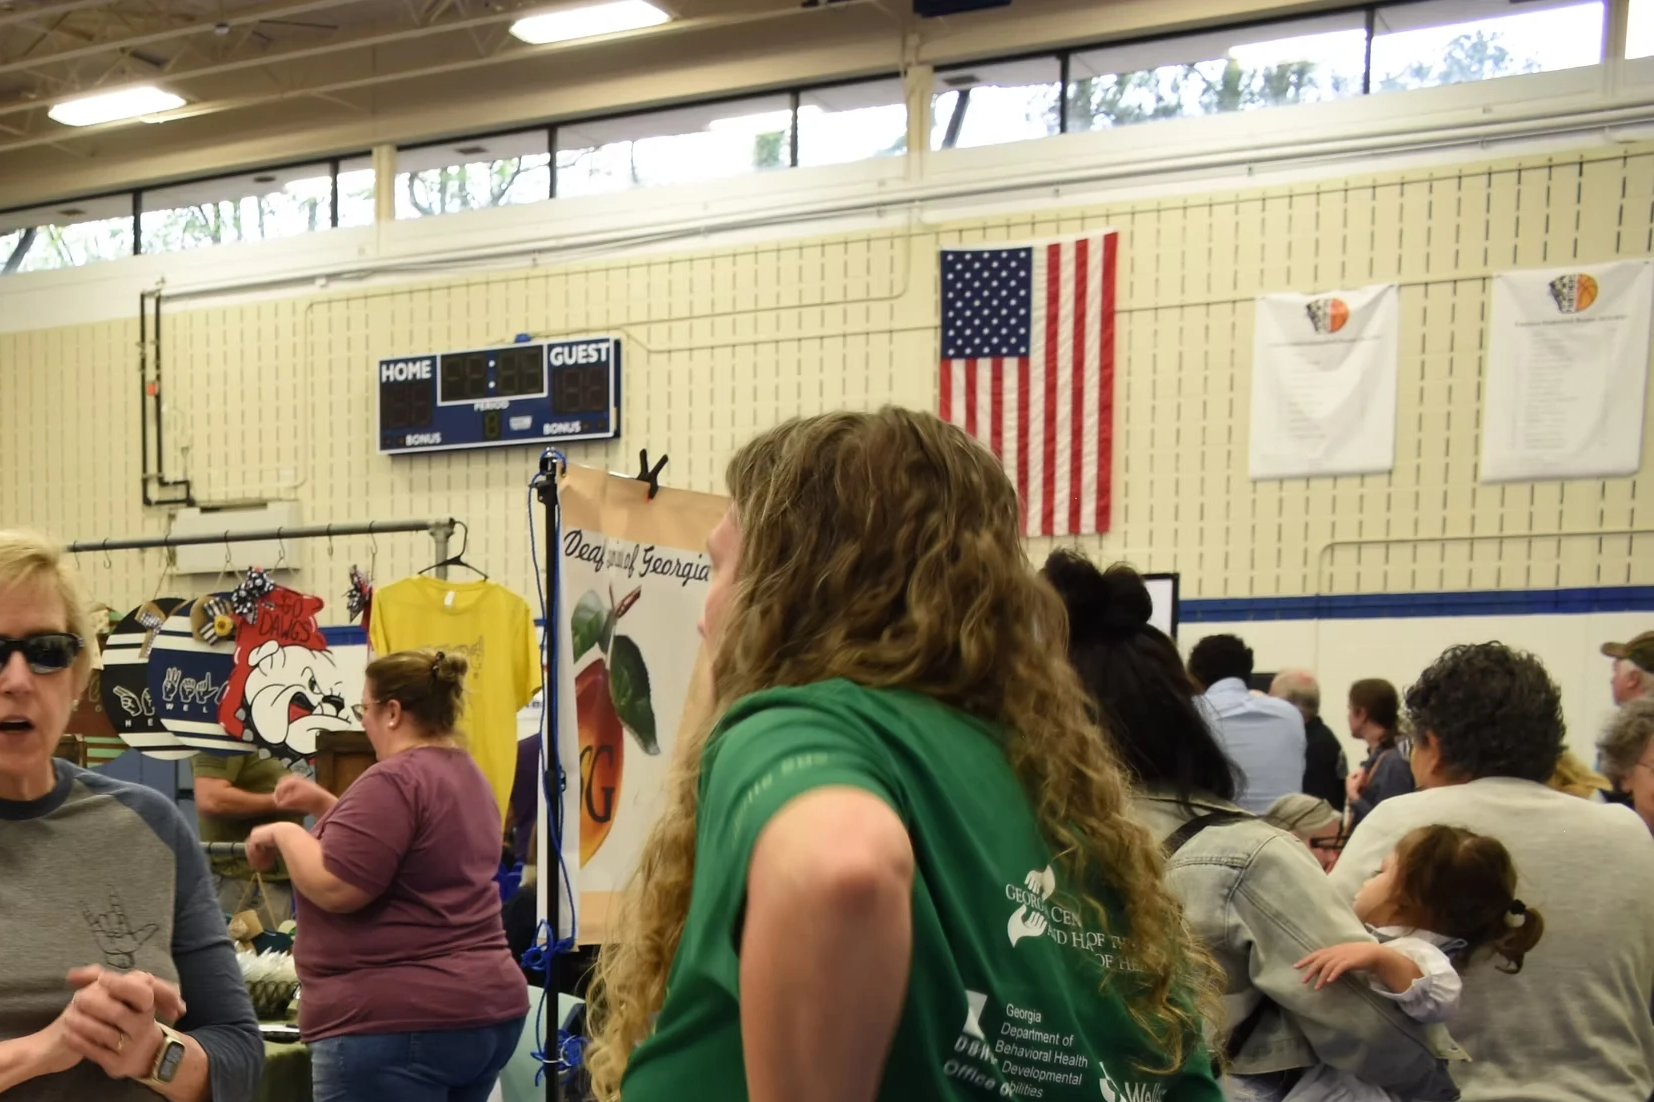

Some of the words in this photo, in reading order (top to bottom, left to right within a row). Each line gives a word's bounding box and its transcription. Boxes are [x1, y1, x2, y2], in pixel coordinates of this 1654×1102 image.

[549, 341, 610, 366] GUEST
[381, 360, 432, 382] HOME
[405, 432, 442, 446] BONUS
[543, 420, 581, 435] BONUS
[564, 529, 605, 573] Deaf
[639, 545, 711, 588] Georgia
[1006, 1003, 1042, 1024] Georgia
[1000, 1022, 1059, 1045] Department
[1062, 1034, 1074, 1047] of
[995, 1039, 1052, 1063] Behavioral
[1054, 1051, 1088, 1068] Health
[943, 1059, 996, 1091] Office
[1002, 1060, 1083, 1086] Developmental
